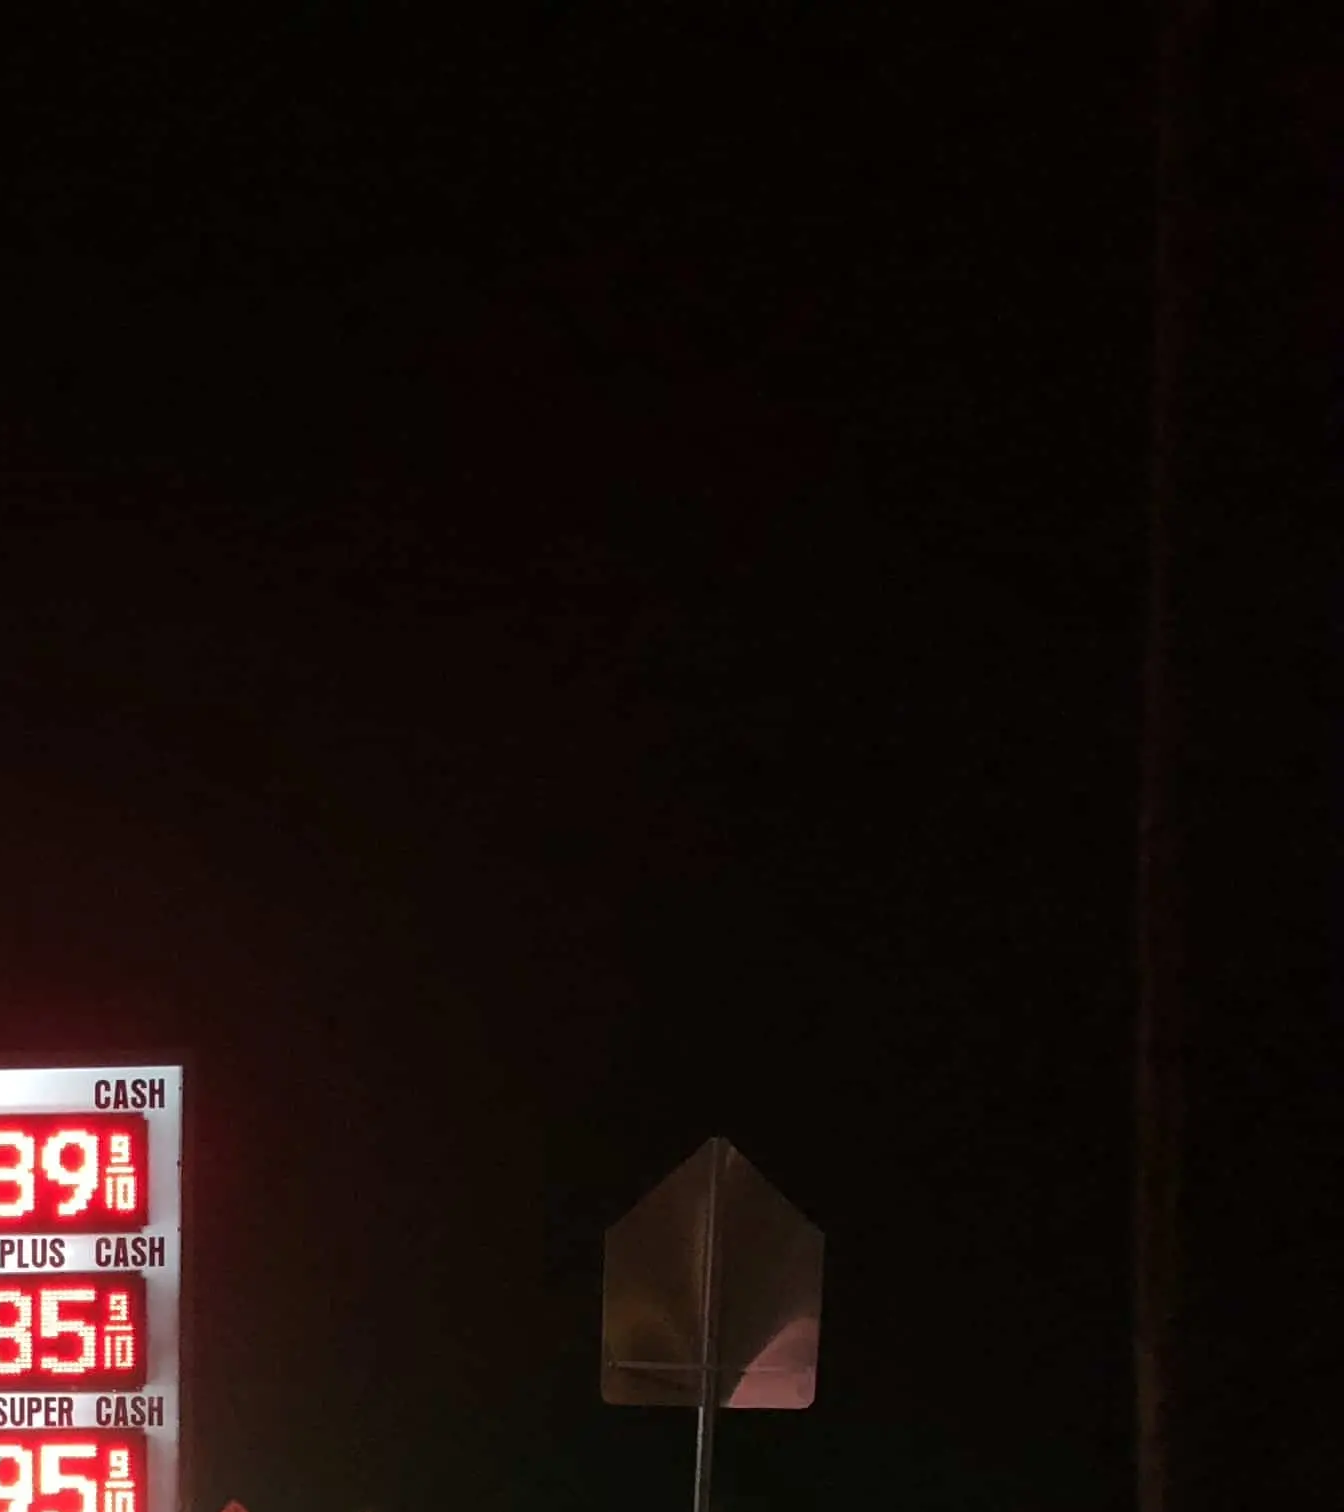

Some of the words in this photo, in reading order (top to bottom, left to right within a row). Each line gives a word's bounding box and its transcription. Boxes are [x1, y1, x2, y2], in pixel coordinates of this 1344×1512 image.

[94, 1078, 166, 1110] CASH
[0, 1238, 66, 1269] PLUS
[95, 1236, 166, 1267] CASH
[95, 1396, 164, 1427] CASH
